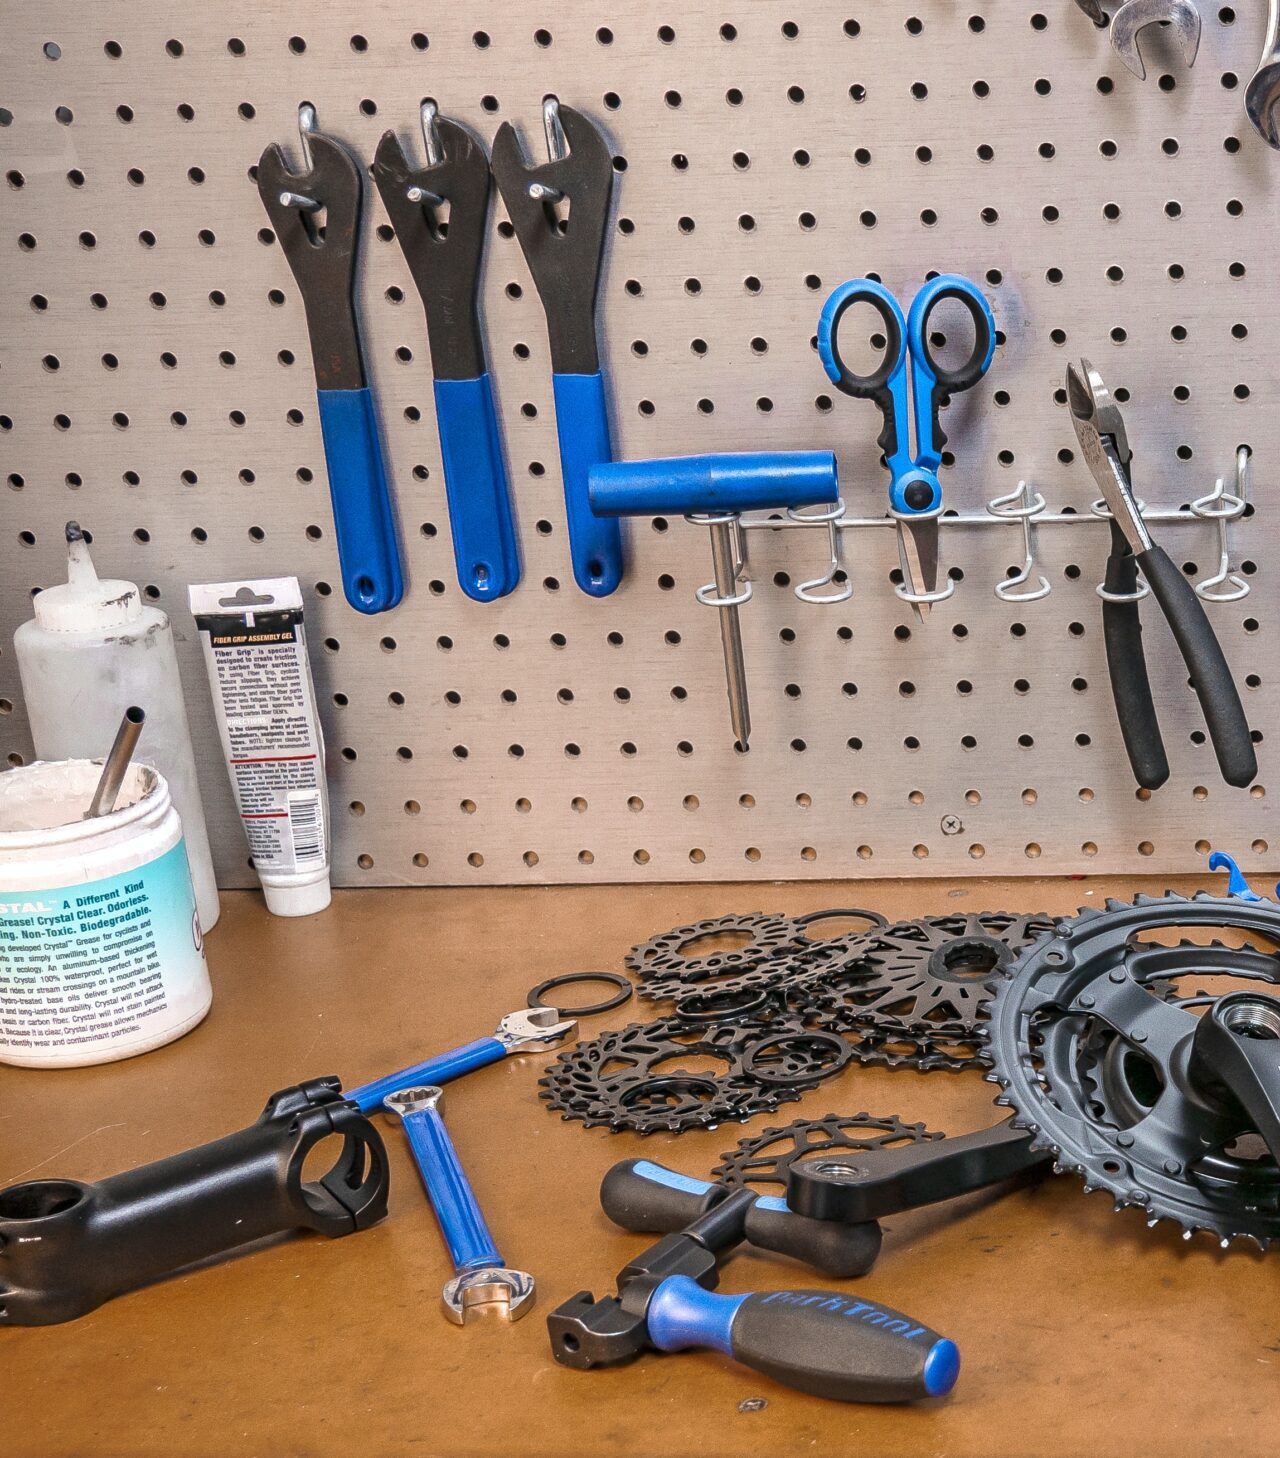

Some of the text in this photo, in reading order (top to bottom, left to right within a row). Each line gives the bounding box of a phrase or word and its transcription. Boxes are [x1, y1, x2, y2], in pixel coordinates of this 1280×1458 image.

[248, 633, 280, 642] ASSEMBLY
[0, 894, 149, 926] Grease! Crystal Clear. Odorless.
[63, 900, 71, 909] A
[76, 889, 120, 907] Different
[124, 880, 144, 894] Kind
[8, 944, 41, 952] developed
[76, 936, 100, 946] Grease
[115, 925, 138, 937] cyclists
[140, 919, 151, 929] and
[21, 926, 77, 939] Non-Toxic.
[80, 906, 151, 932] Biodegradable.
[17, 966, 43, 974] ecology.
[62, 953, 120, 970] aluminum-based
[124, 941, 155, 956] thickening
[29, 954, 50, 962] simply
[56, 949, 88, 960] unwilling
[103, 934, 142, 951] compromise
[14, 976, 36, 985] Crystal
[41, 975, 60, 983] 100%
[108, 960, 131, 973] perfect
[146, 951, 158, 960] wet
[36, 986, 60, 994] stream
[63, 981, 96, 992] crossings
[116, 967, 146, 981] mountain
[18, 1008, 57, 1016] long-lasting
[95, 997, 119, 1008] Crystal
[120, 992, 132, 1001] will
[134, 989, 144, 997] not
[146, 982, 163, 994] attack
[84, 989, 107, 999] deliver
[112, 981, 136, 993] smooth
[139, 972, 162, 984] bearing
[5, 1028, 30, 1036] Because
[64, 1025, 88, 1035] Crystal
[90, 1021, 112, 1031] grease
[114, 1015, 135, 1025] allows
[136, 1003, 167, 1019] mechanics
[72, 1013, 96, 1023] Crystal
[98, 1010, 111, 1018] will
[127, 1002, 142, 1011] stain
[144, 991, 165, 1006] painted
[66, 1032, 109, 1044] contaminant
[111, 1025, 141, 1038] particles.
